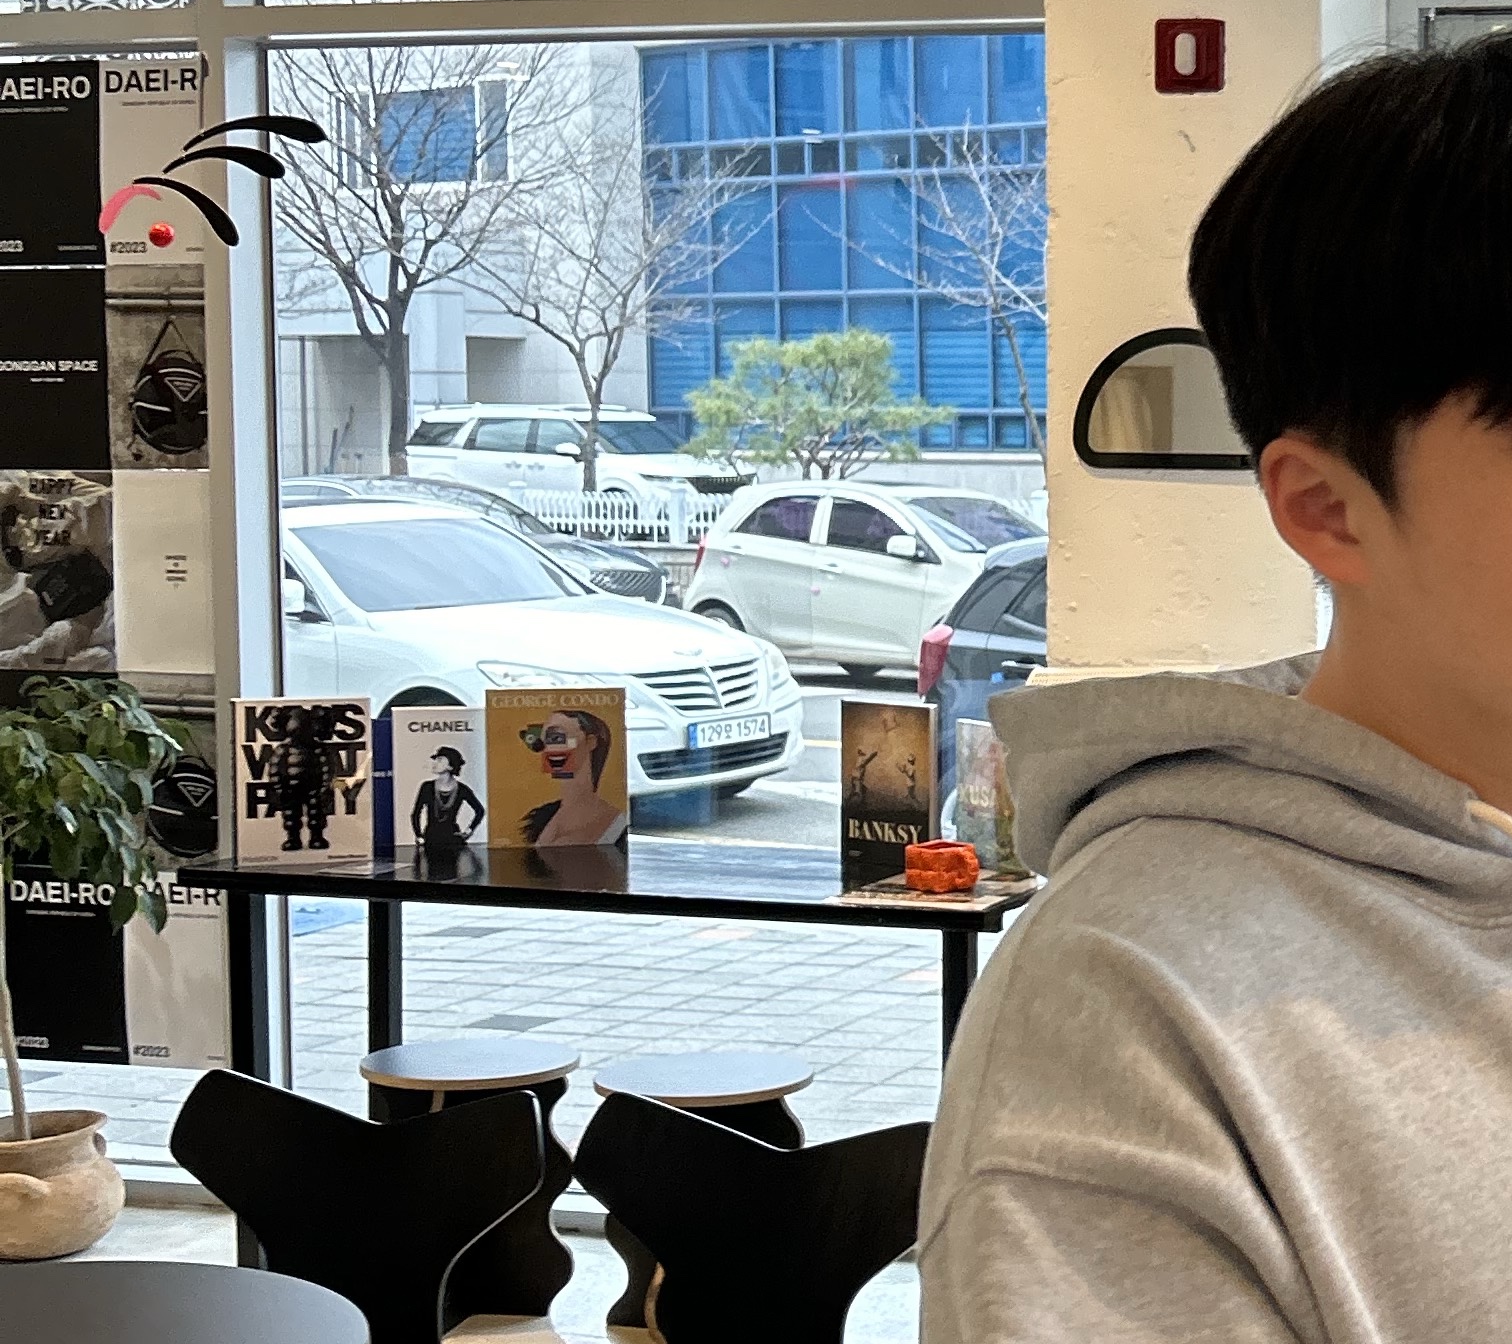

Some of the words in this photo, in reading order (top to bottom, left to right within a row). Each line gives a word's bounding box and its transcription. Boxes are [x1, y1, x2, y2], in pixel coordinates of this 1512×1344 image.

[0, 76, 91, 100] AEI-RO
[105, 68, 197, 93] DAEI-R
[58, 360, 98, 371] SPACE
[561, 693, 619, 707] CONDO
[244, 704, 366, 743] KS
[408, 720, 474, 733] CHANEL
[737, 718, 766, 737] 1574
[848, 818, 922, 844] BANKSY
[9, 880, 116, 905] DAEI-RO
